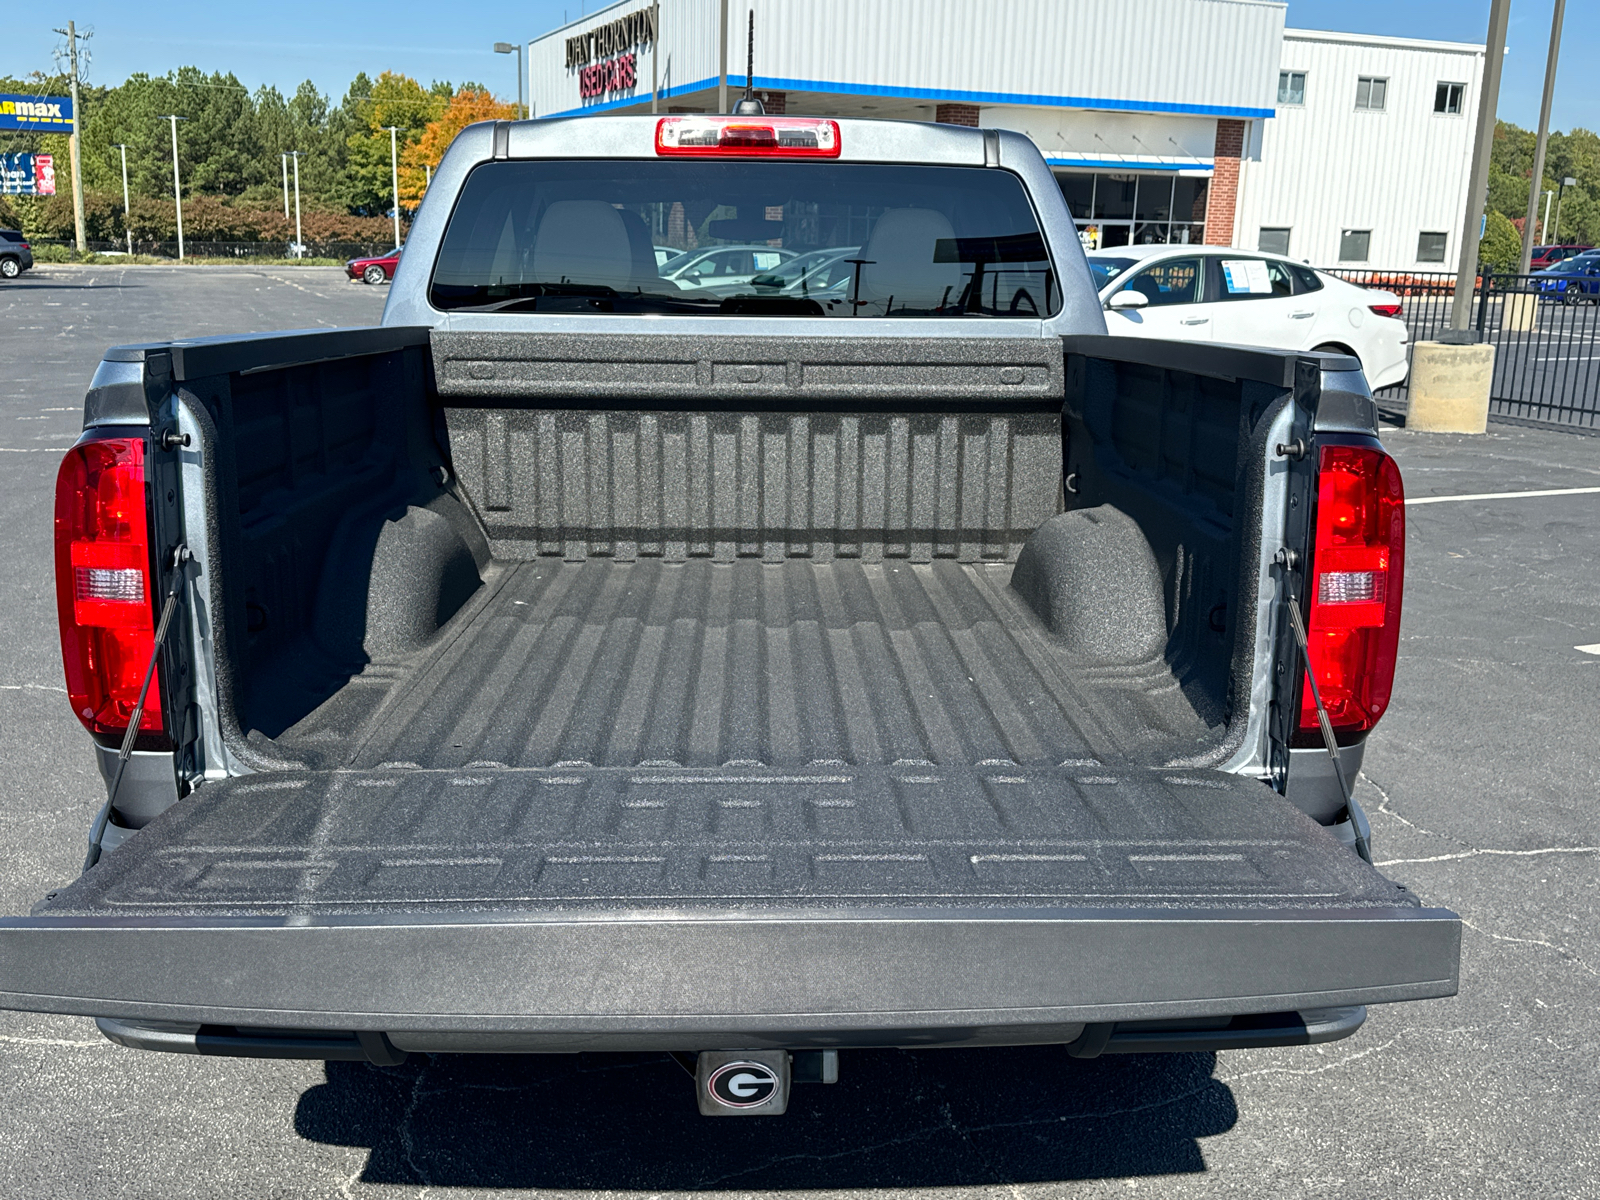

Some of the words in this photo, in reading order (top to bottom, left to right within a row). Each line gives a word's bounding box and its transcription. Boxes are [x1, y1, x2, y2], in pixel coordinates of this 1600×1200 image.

[565, 31, 591, 68] JOHN
[592, 4, 660, 59] THORNTON
[580, 64, 604, 98] USED
[605, 53, 636, 92] CARS
[0, 100, 62, 117] Rmax
[728, 1073, 774, 1097] G
